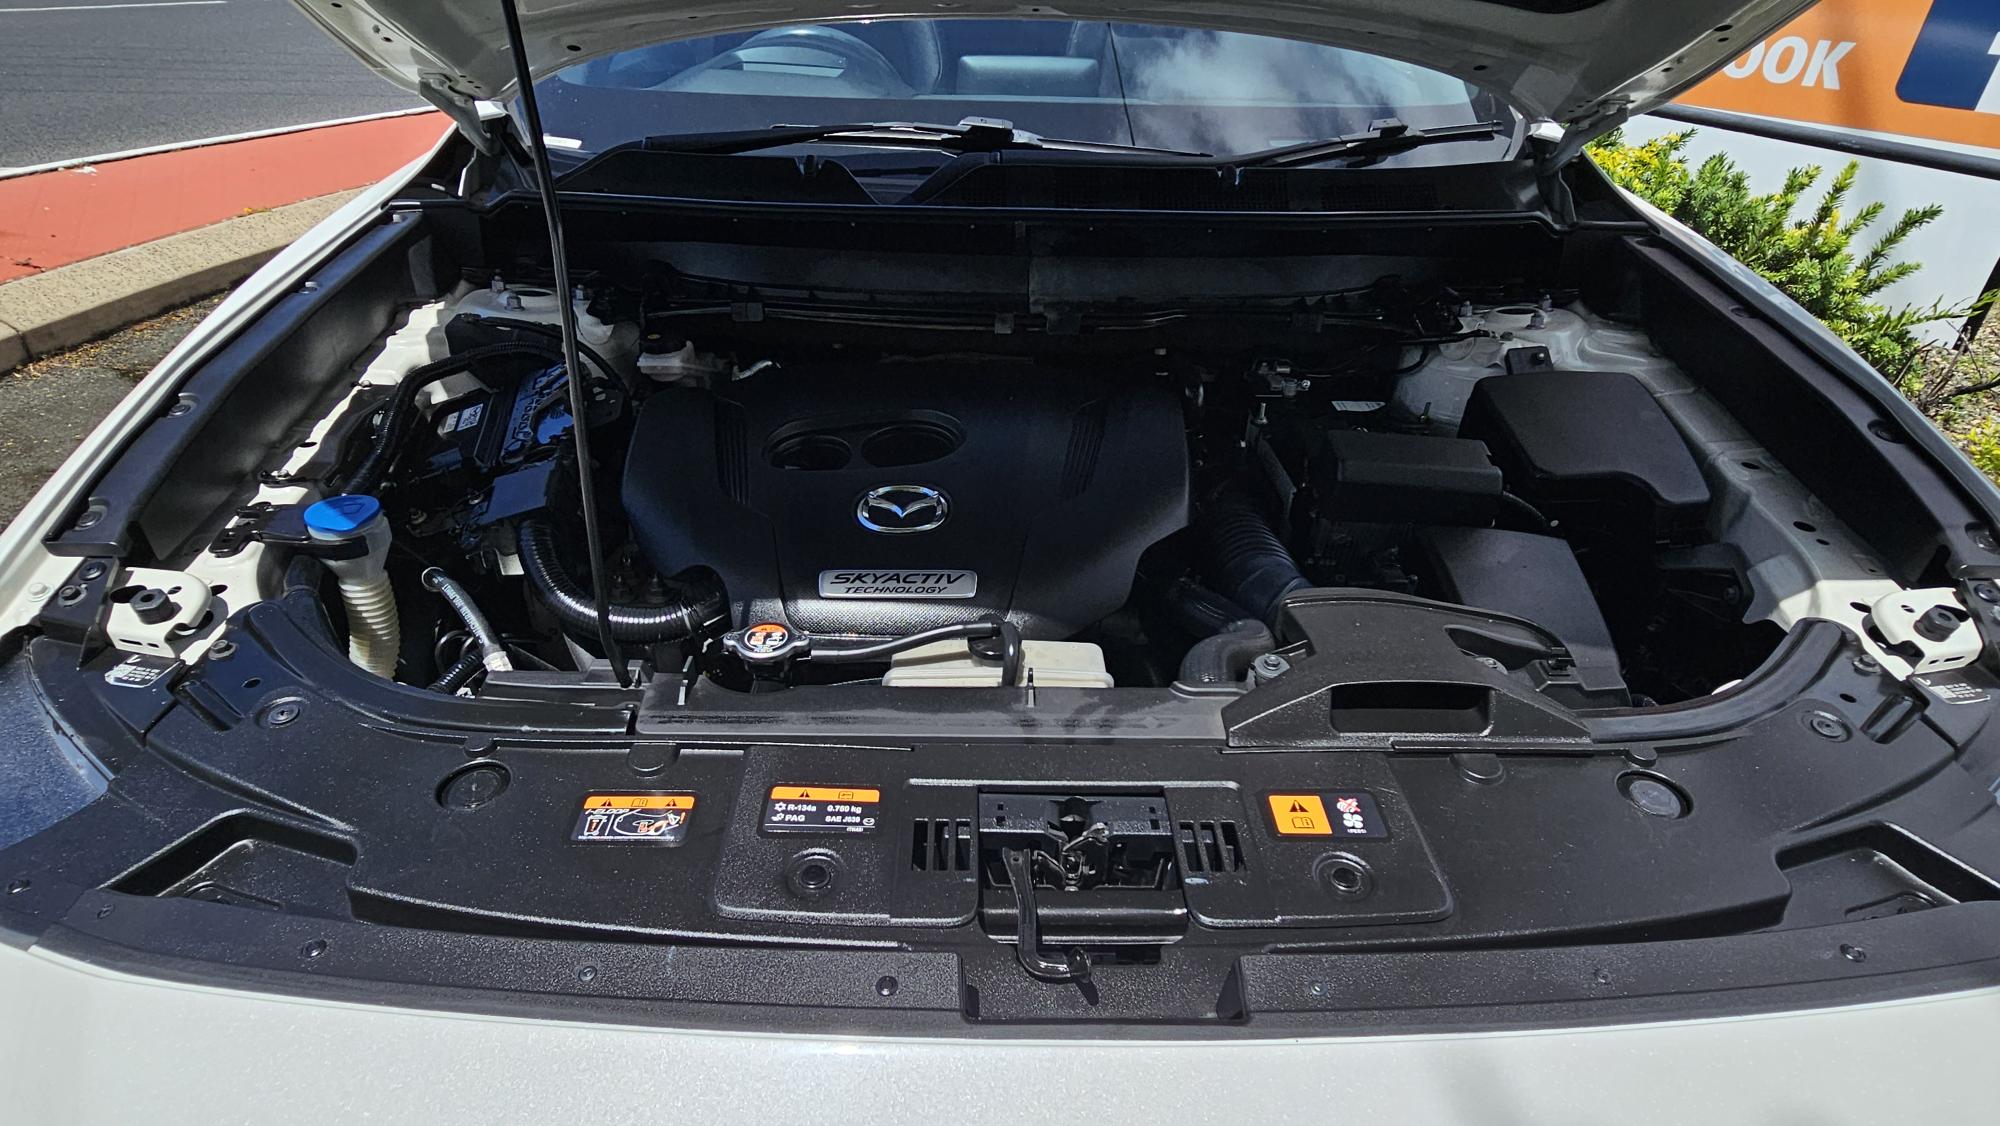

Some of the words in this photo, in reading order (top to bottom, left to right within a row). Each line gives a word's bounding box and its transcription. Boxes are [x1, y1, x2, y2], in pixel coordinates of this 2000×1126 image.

[830, 573, 966, 585] SKYACTIV
[844, 586, 948, 594] TECHNOLOGY
[787, 804, 817, 812] R-134a
[851, 805, 862, 814] kg
[785, 814, 806, 822] PAG
